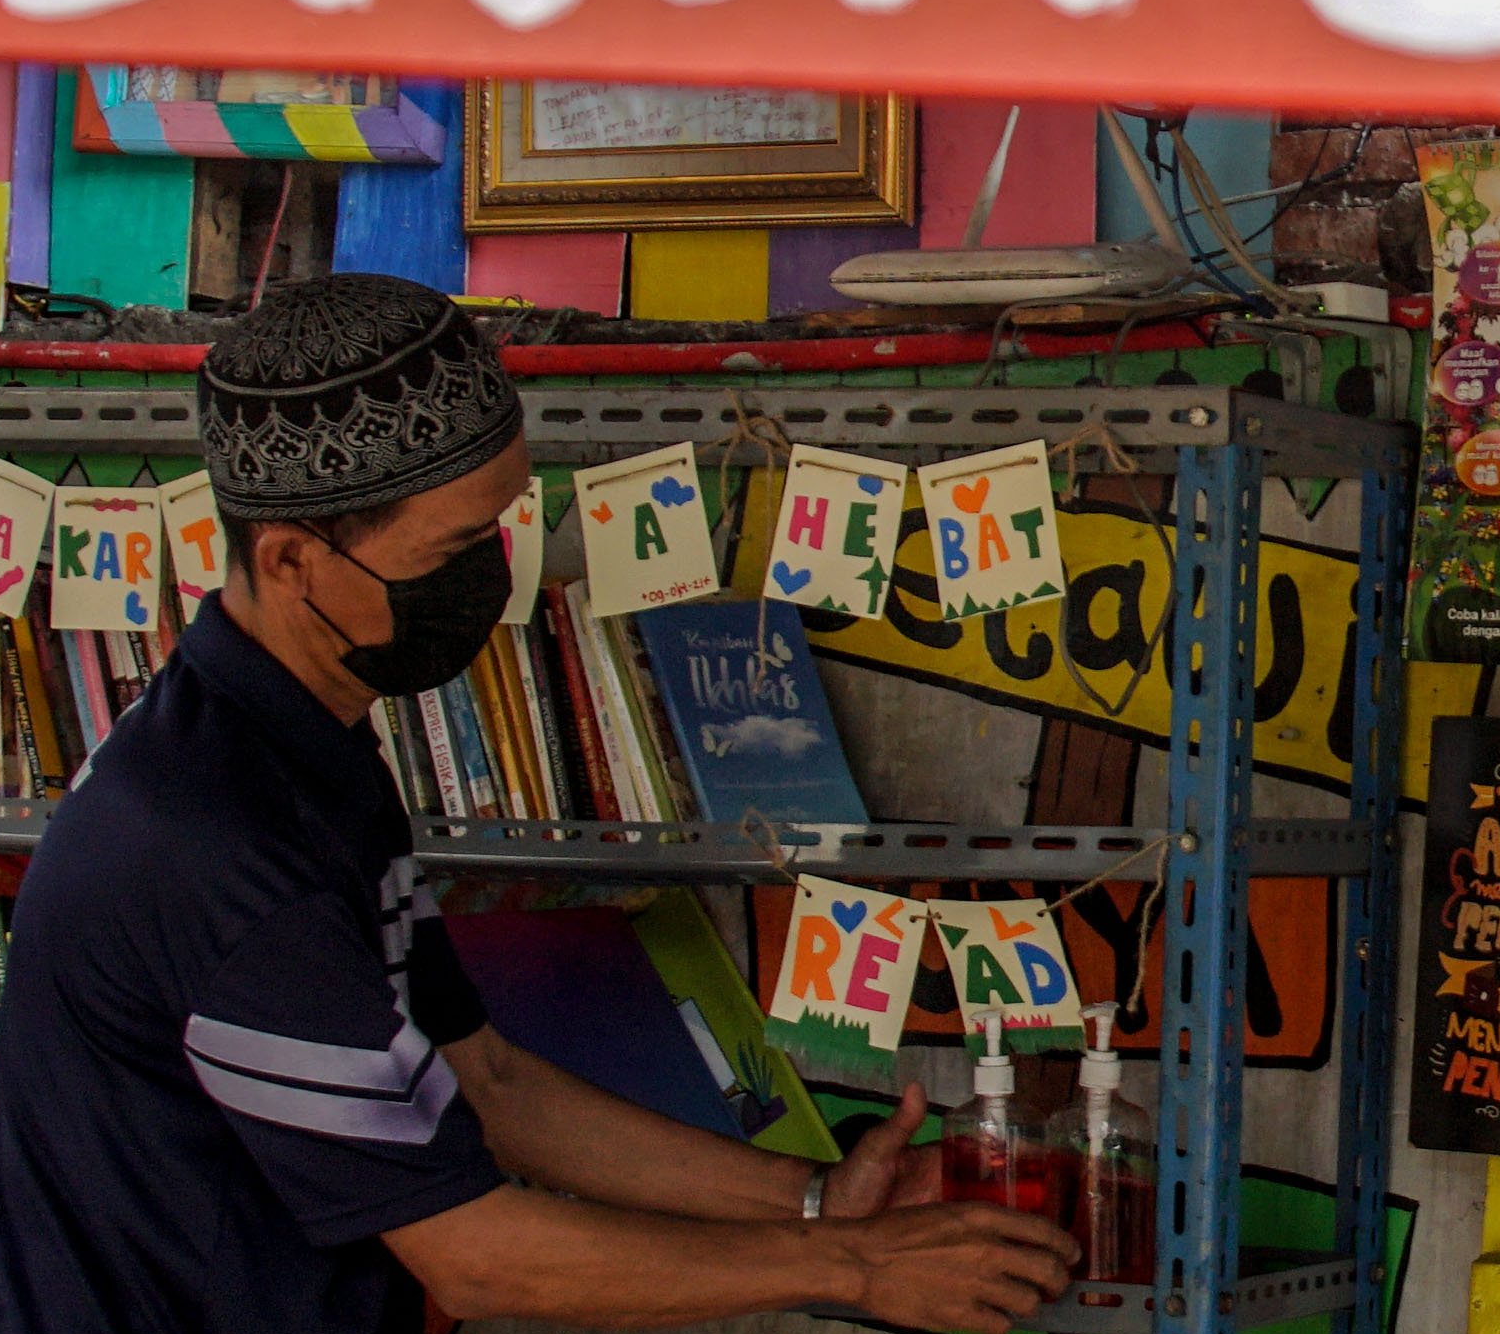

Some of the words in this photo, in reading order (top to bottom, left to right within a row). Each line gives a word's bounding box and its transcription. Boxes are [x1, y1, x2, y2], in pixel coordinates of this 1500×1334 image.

[1447, 608, 1479, 621] Coba
[421, 691, 444, 741] EKSPRES
[433, 744, 455, 795] FISIKA
